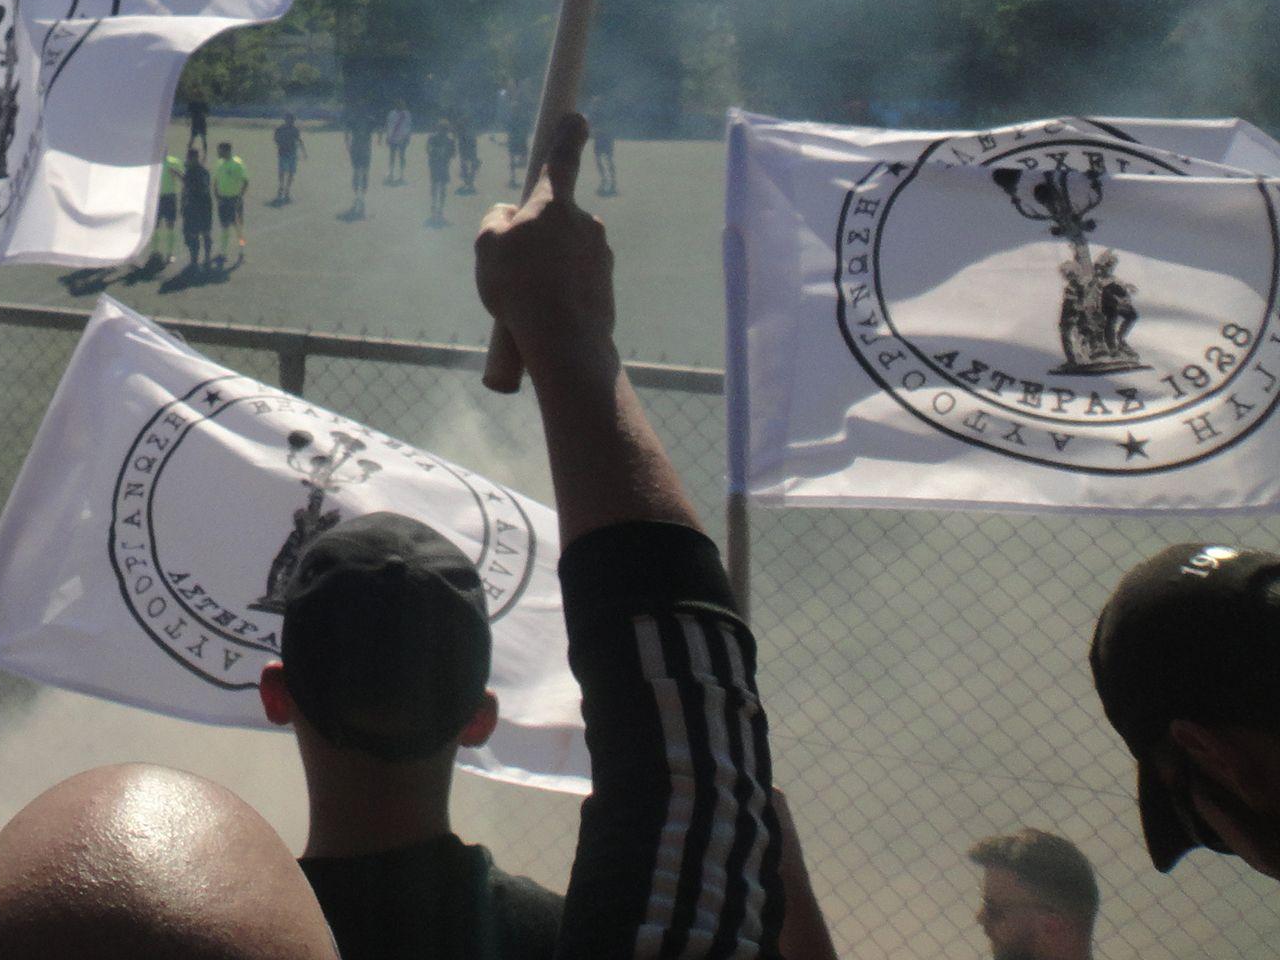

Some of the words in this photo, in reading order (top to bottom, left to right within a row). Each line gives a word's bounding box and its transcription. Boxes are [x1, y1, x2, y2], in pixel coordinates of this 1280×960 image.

[933, 350, 1145, 414] ΑΣΤΕΡΑΣ
[1160, 322, 1252, 399] 1928
[167, 569, 279, 647] ΑΣΤΕΡΑ
